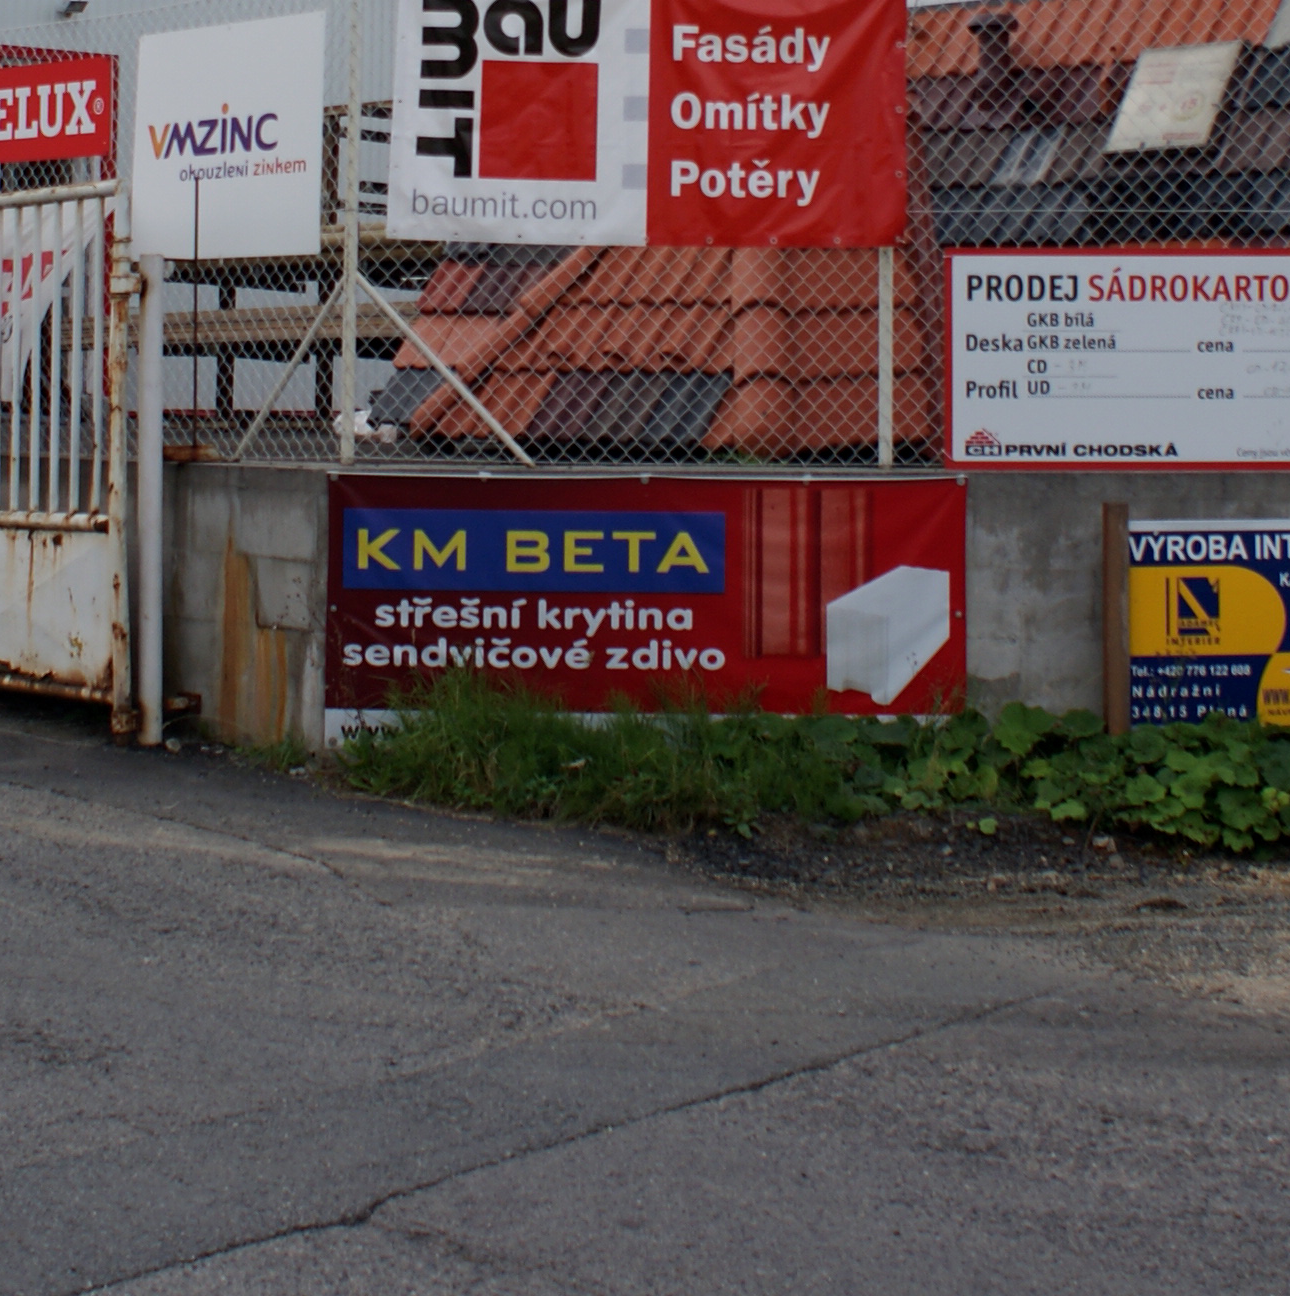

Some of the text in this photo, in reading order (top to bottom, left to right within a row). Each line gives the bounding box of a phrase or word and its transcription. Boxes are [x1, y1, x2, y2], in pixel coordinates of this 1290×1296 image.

[671, 25, 830, 72] Fasády
[670, 92, 830, 139] Omítky
[252, 157, 307, 176] zinkem
[670, 159, 820, 207] Potěry
[411, 188, 598, 221] baumit.com
[967, 274, 1078, 302] PRODEJ
[1027, 313, 1059, 327] GKB
[1064, 312, 1095, 328] bílá
[966, 334, 1023, 353] Deska
[1027, 335, 1059, 350] GKB
[1063, 334, 1117, 350] zelená
[1197, 340, 1234, 353] cena
[1027, 359, 1048, 374] CD
[966, 380, 1018, 399] Profil
[1027, 380, 1051, 395] UD
[1197, 387, 1235, 400] cena
[1004, 442, 1066, 457] PRVNÍ
[1073, 442, 1179, 457] CHODSKÁ
[357, 528, 710, 574] KM BETA
[1129, 530, 1249, 562] VÝROBA
[374, 597, 693, 638] střešní krytina
[342, 636, 727, 672] sendvičové zdivo
[1196, 704, 1248, 719] Pná
